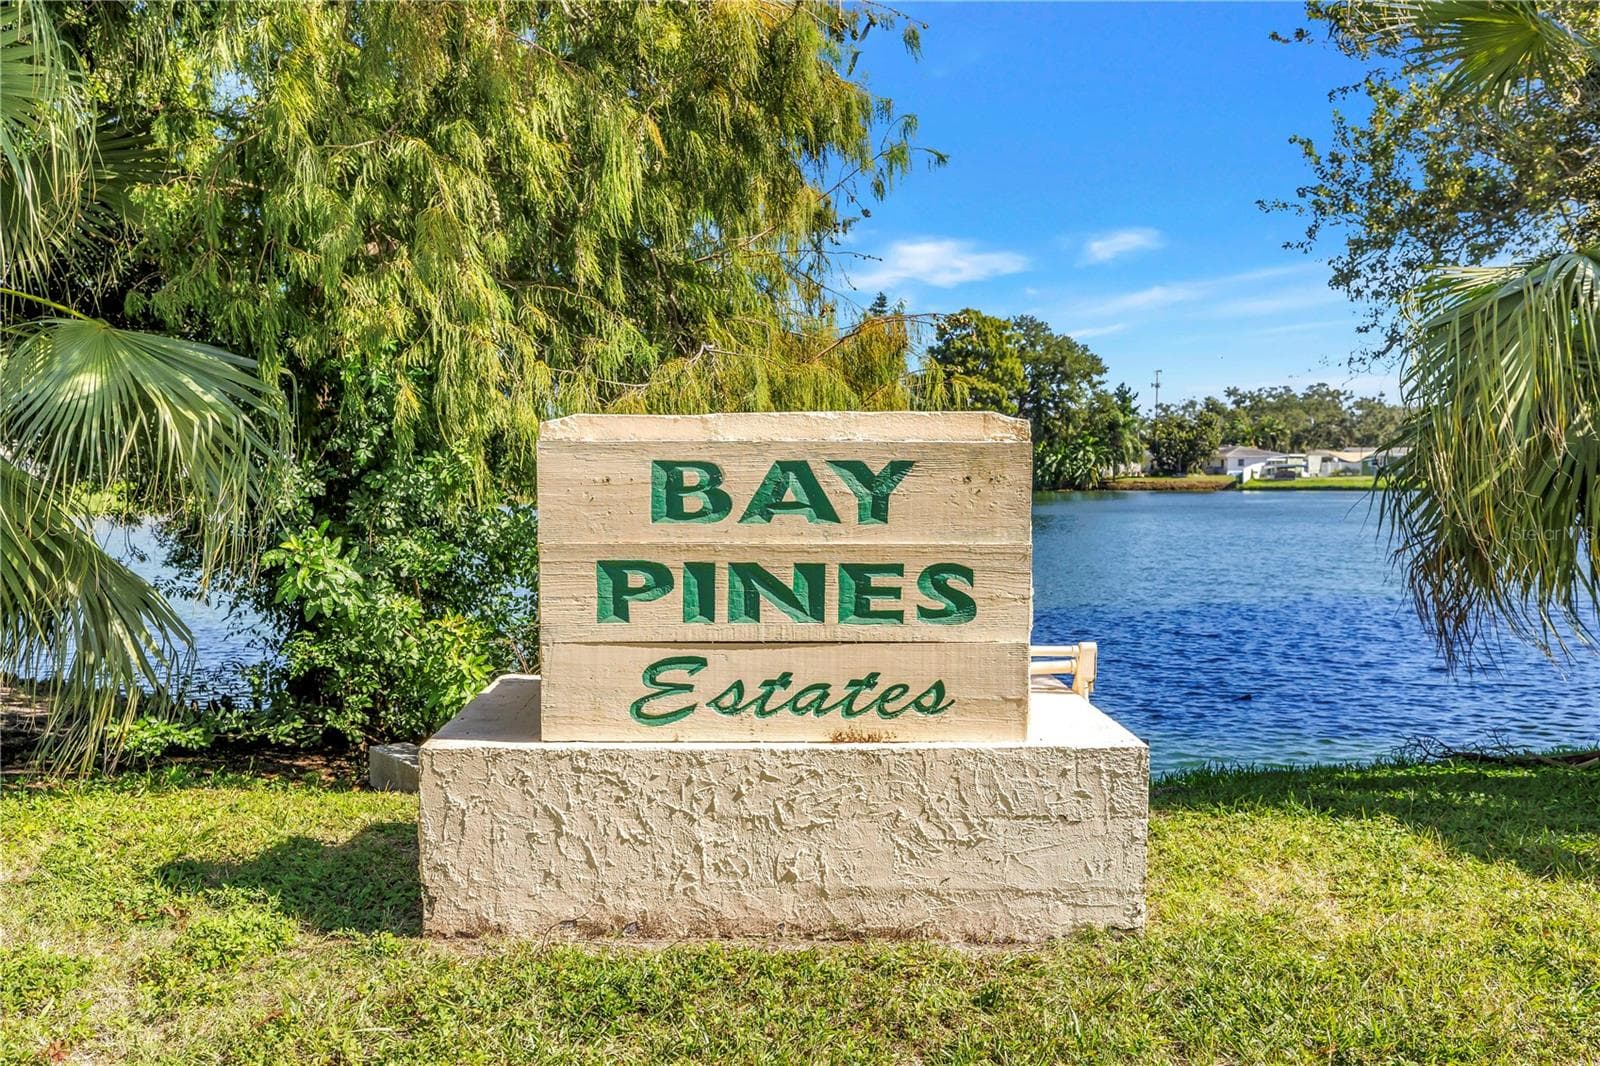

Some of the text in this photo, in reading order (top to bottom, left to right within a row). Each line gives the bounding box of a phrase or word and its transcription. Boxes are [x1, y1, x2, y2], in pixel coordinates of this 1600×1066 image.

[651, 460, 914, 525] BAY
[596, 560, 978, 625] PINES
[629, 655, 955, 727] Estates
